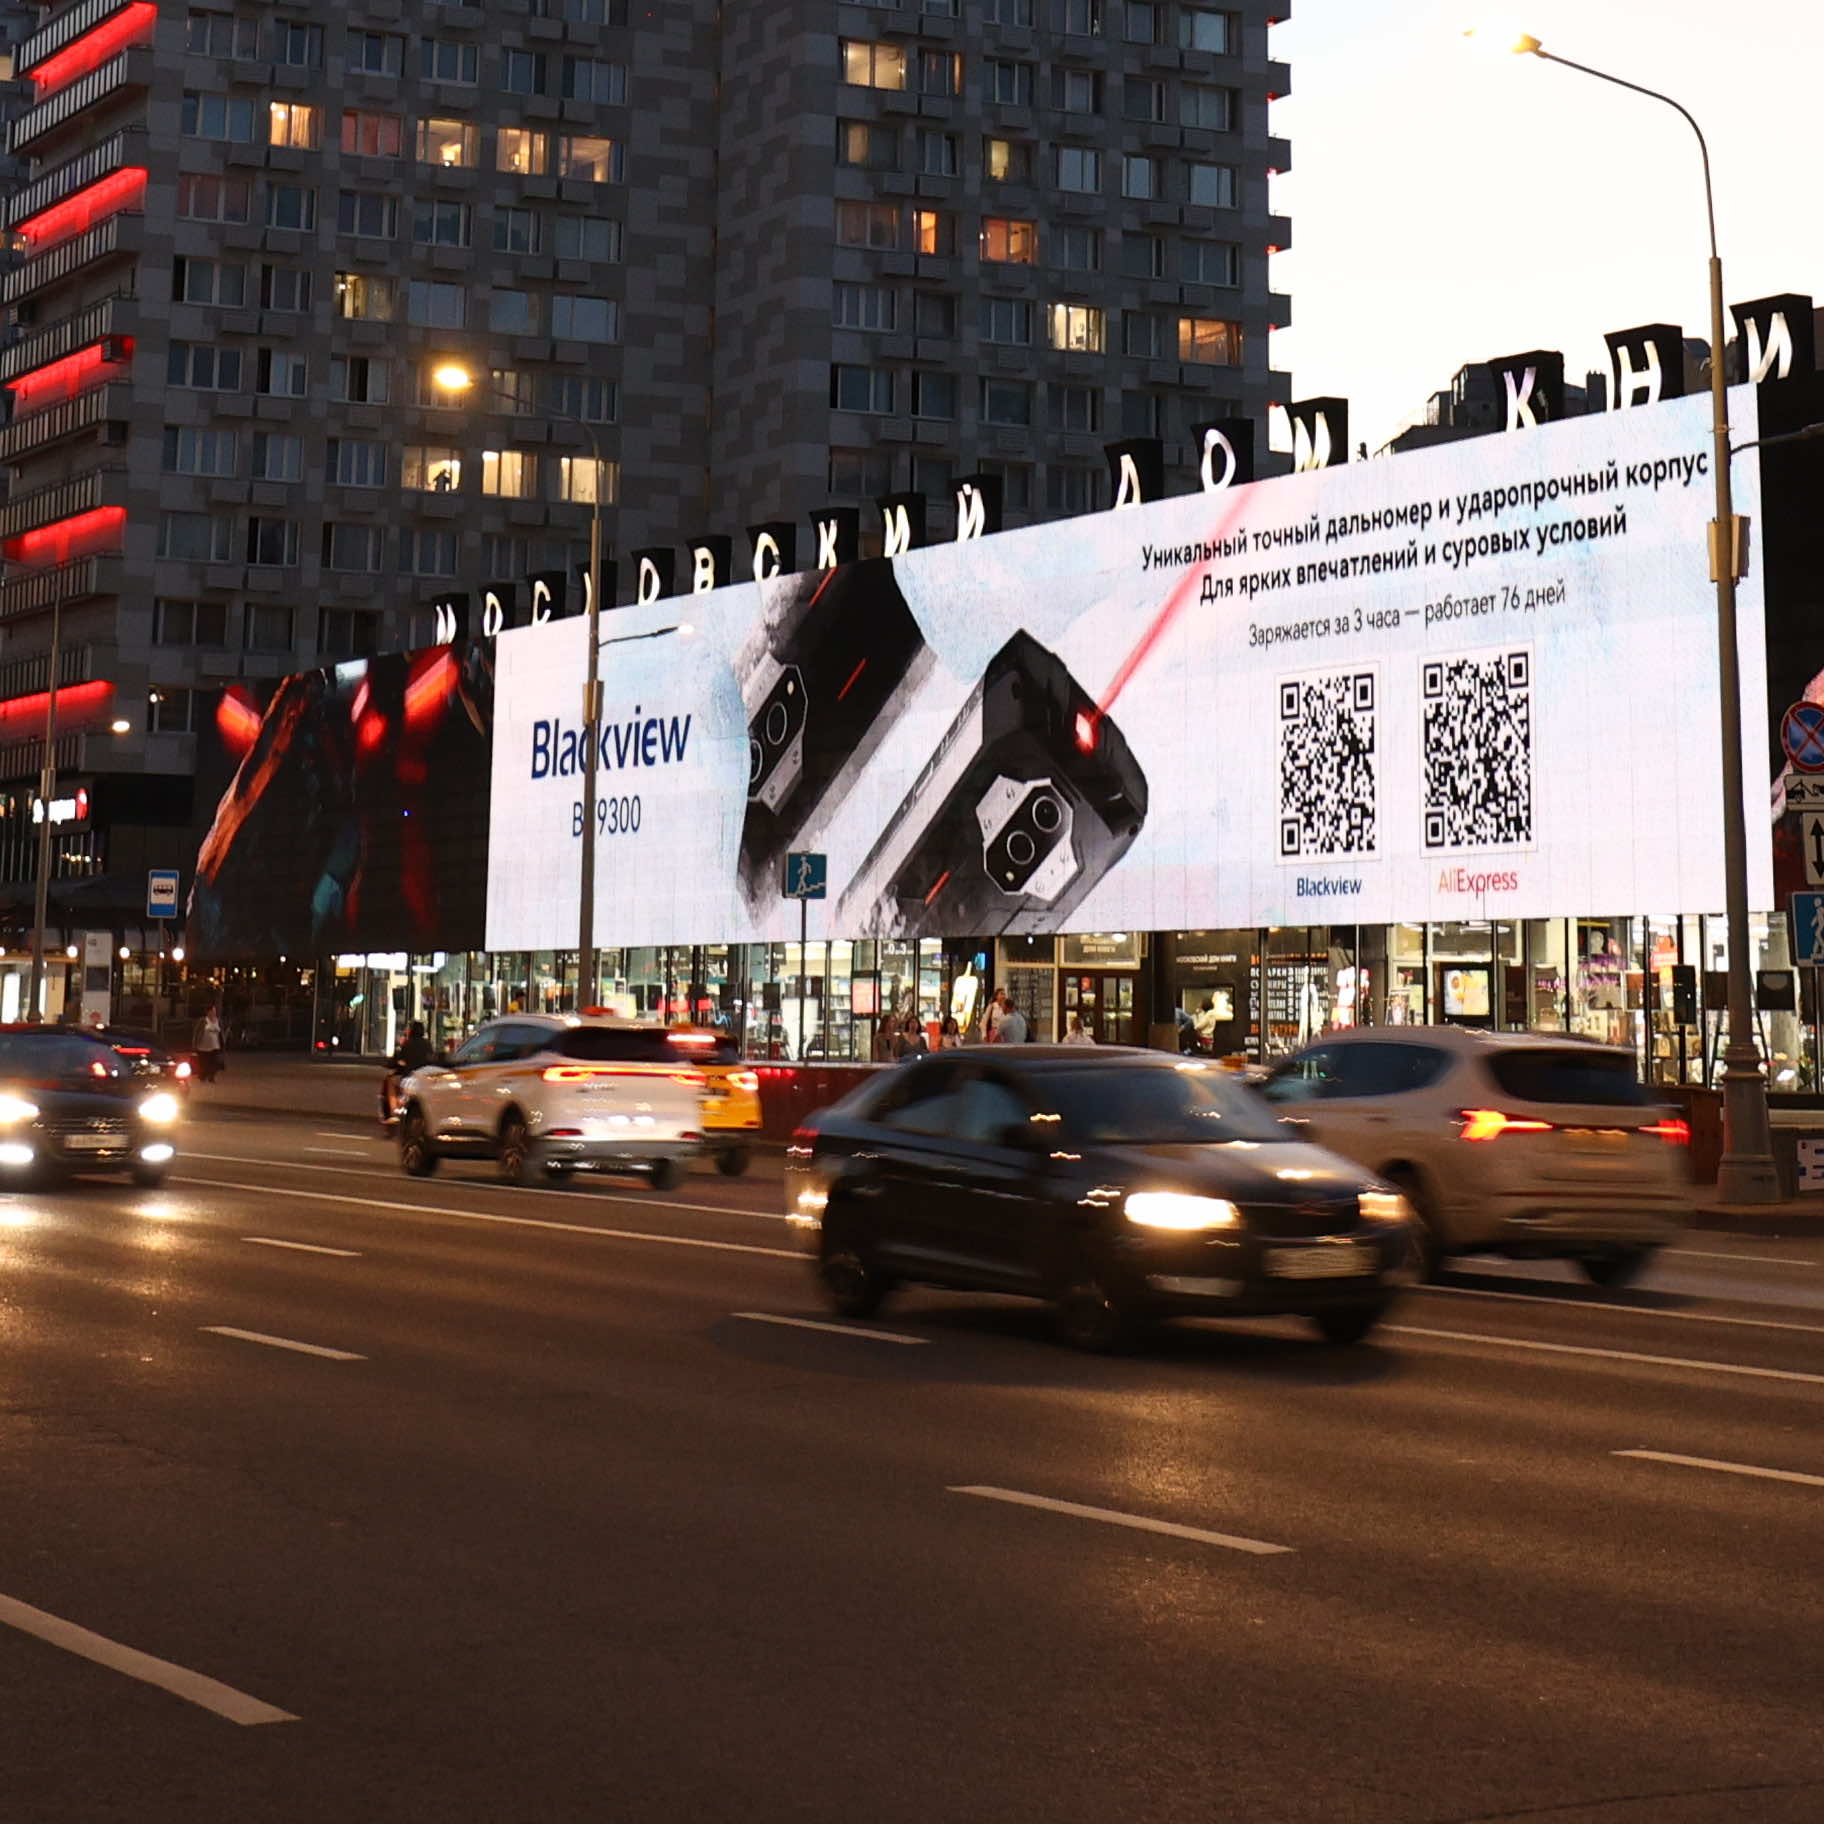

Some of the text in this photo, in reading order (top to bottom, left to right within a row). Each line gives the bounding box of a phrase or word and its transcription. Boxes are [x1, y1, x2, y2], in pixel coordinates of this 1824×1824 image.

[1142, 451, 1708, 571] Уникальный точный дальномер и ударопрочный корпус
[1200, 505, 1626, 606] Для ярких впечатлений и суровых условий
[1249, 617, 1330, 651] Заряжается
[1334, 614, 1349, 634] за
[1353, 608, 1362, 632] 3
[1366, 608, 1400, 631] часа
[1425, 593, 1496, 623] работает
[1501, 585, 1520, 610] 76
[1525, 578, 1565, 613] дней
[572, 795, 641, 837] B9300
[1297, 875, 1362, 897] Blackview
[1438, 868, 1518, 900] AliExpress
